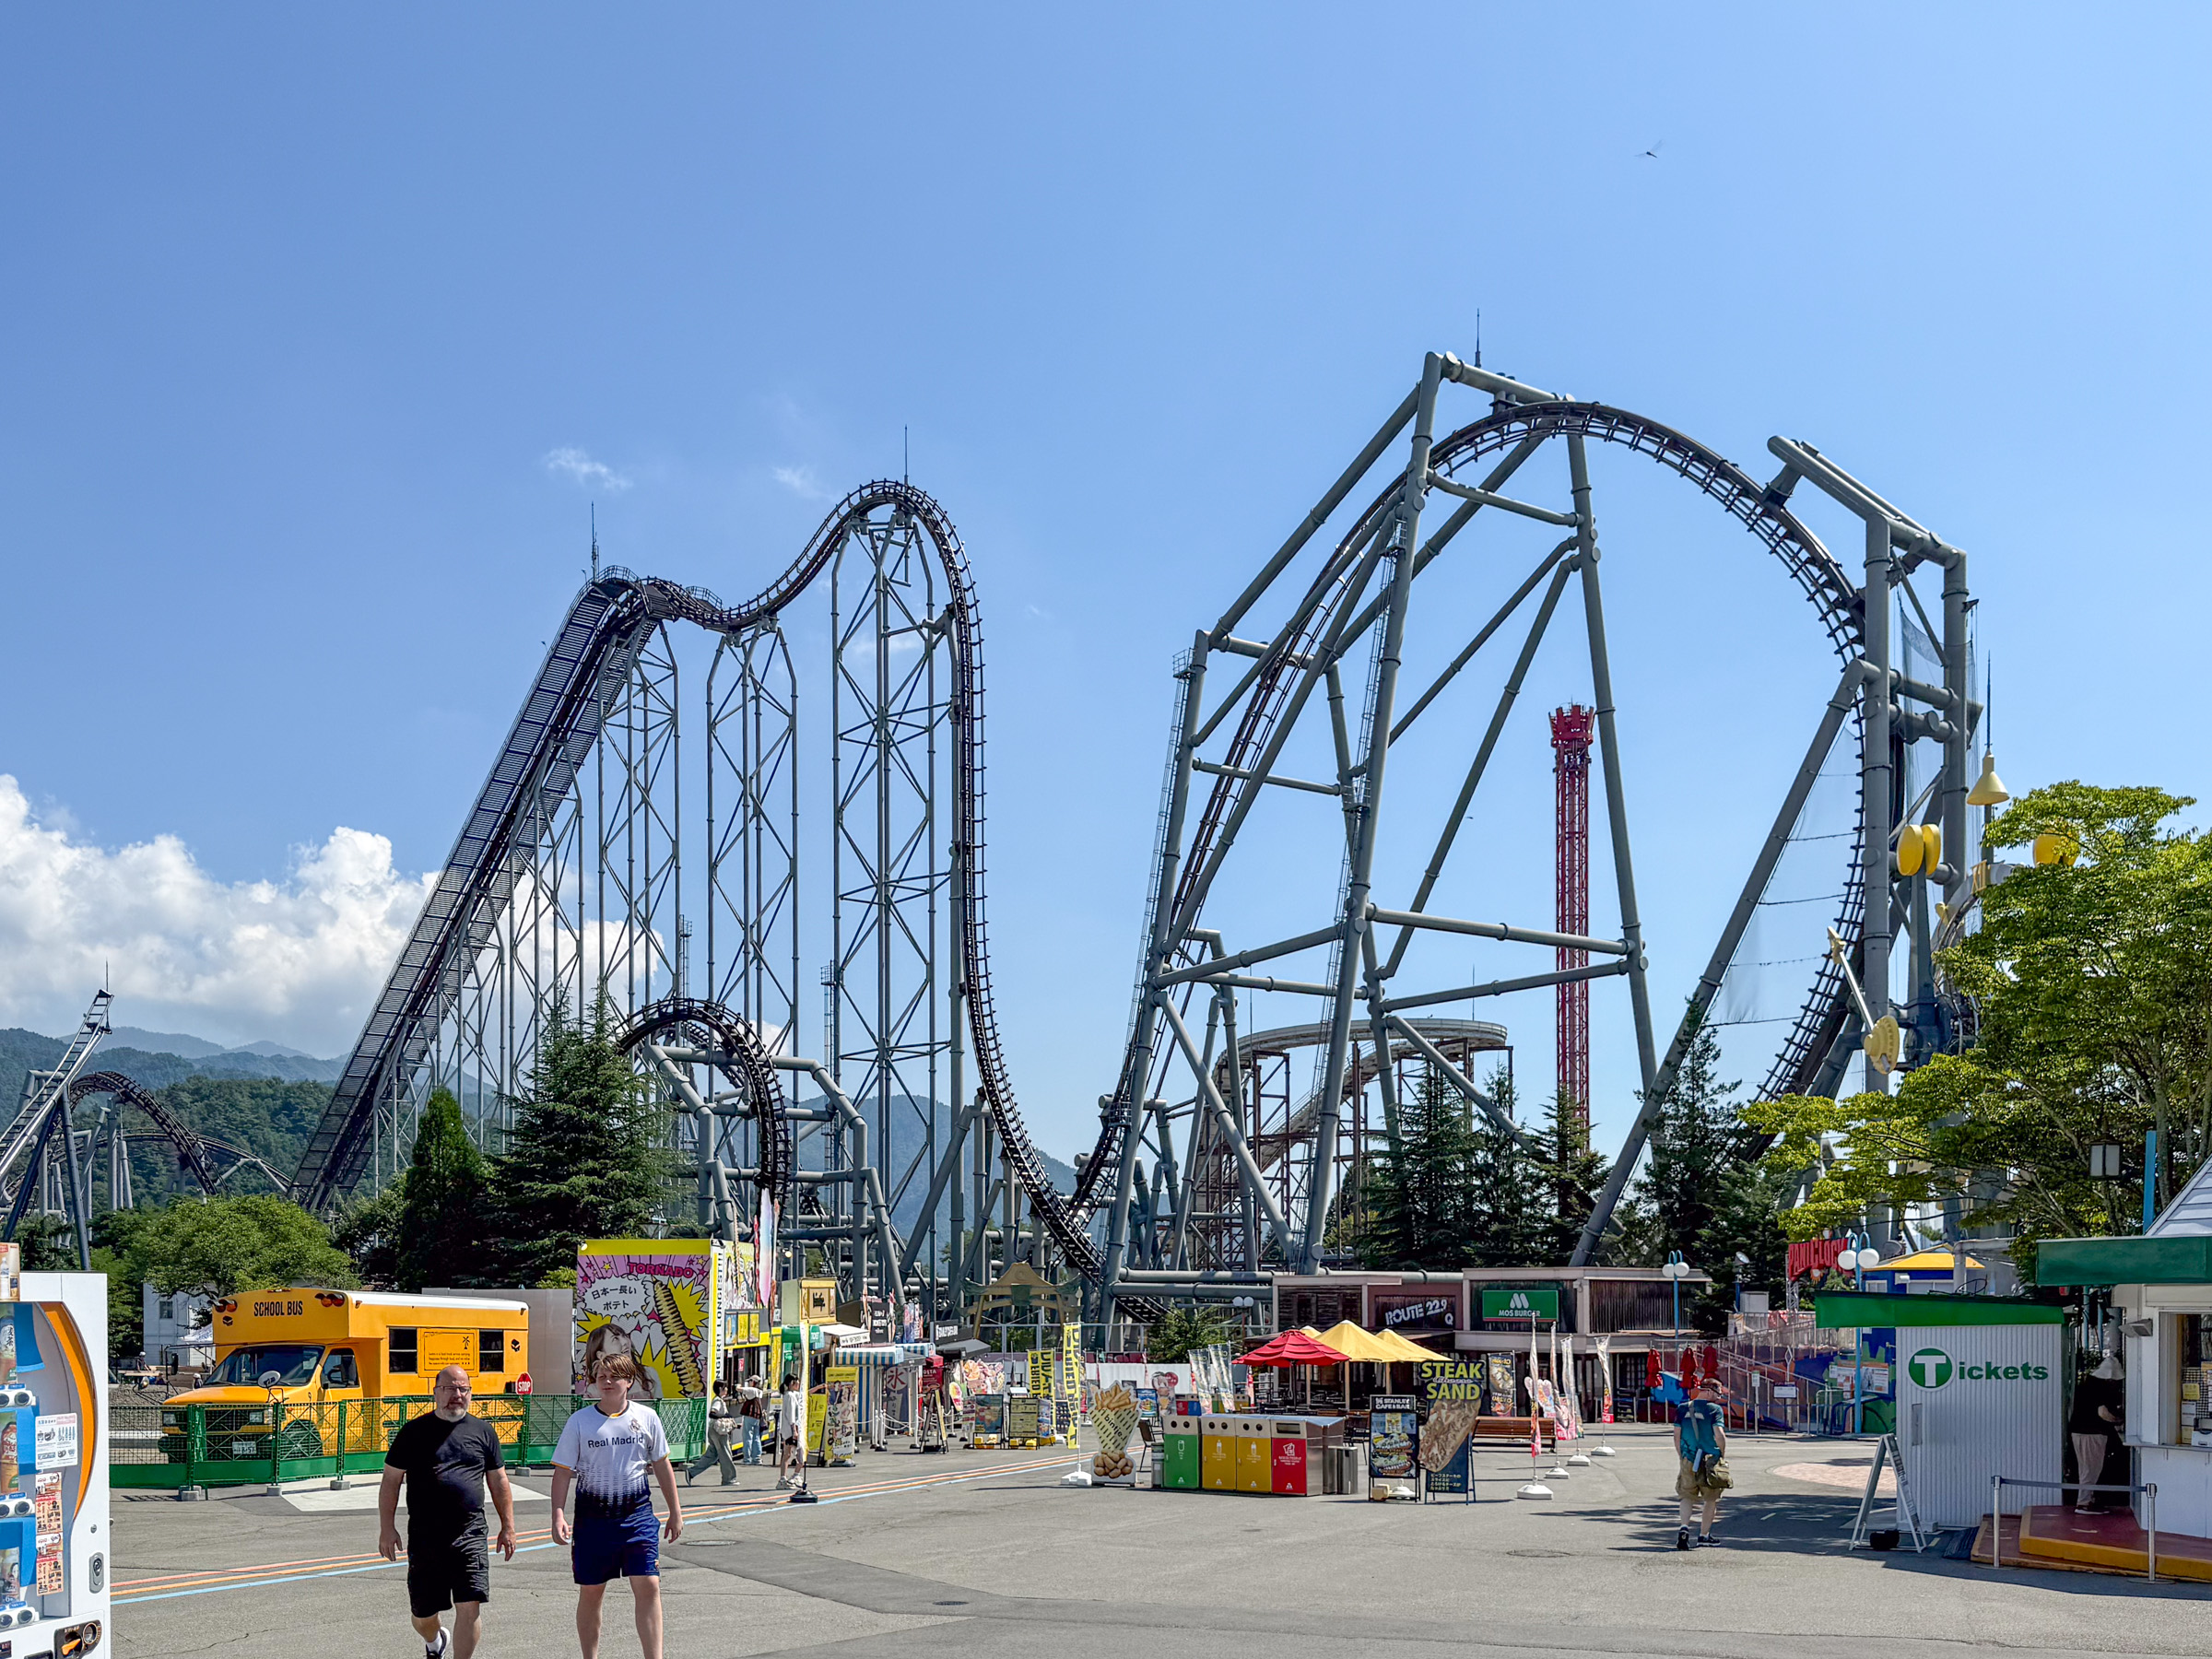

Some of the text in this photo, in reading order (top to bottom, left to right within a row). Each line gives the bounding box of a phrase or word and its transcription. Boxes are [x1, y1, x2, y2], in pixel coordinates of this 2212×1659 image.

[627, 1262, 694, 1278] TORNADO
[591, 1285, 637, 1300] 日本一長い
[253, 1300, 303, 1316] SCHOOL BUS
[603, 1300, 629, 1312] ポテト
[1385, 1303, 1425, 1325] ROUTE
[1444, 1312, 1453, 1325] Q
[887, 1367, 907, 1390] 氷
[1420, 1362, 1482, 1379] STEAK
[1913, 1355, 2049, 1386] Tickets
[518, 1380, 531, 1392] STOP
[1426, 1382, 1480, 1400] SAND
[587, 1434, 643, 1449] Real Madrid
